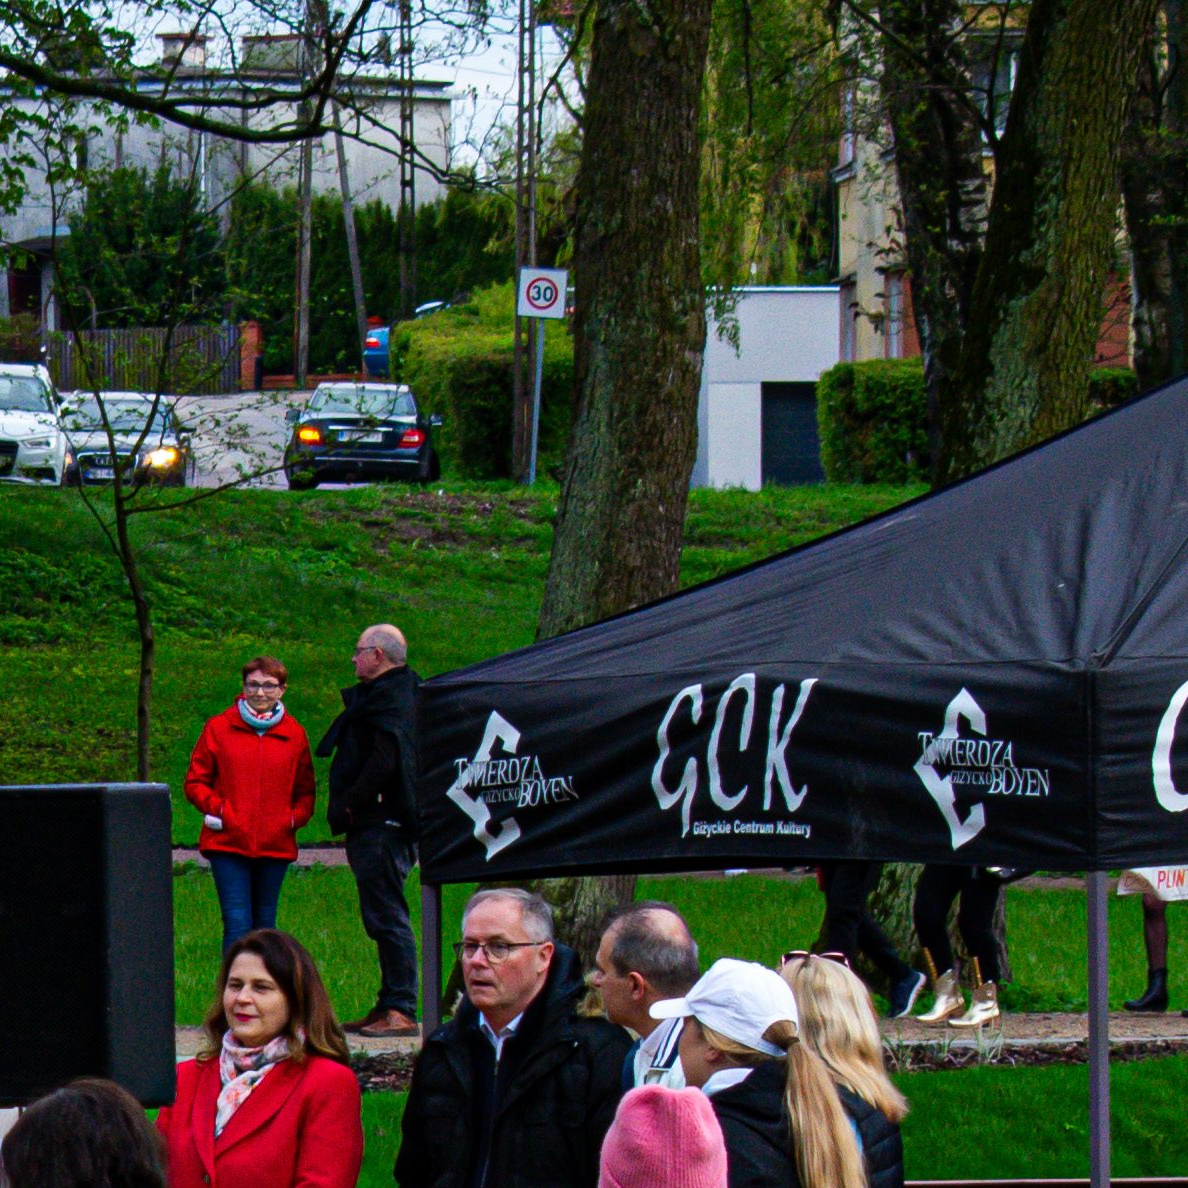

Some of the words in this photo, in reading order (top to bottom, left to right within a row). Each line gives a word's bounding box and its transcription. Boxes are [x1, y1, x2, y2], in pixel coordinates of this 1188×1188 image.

[532, 285, 554, 302] 30
[917, 731, 1015, 767] TWIERDZA
[517, 776, 579, 808] BOYEN
[987, 766, 1050, 796] BOYEN
[693, 821, 731, 838] Giżyckie
[734, 820, 774, 834] Centrum
[776, 821, 811, 839] Kultury
[1157, 869, 1188, 890] PLIN
